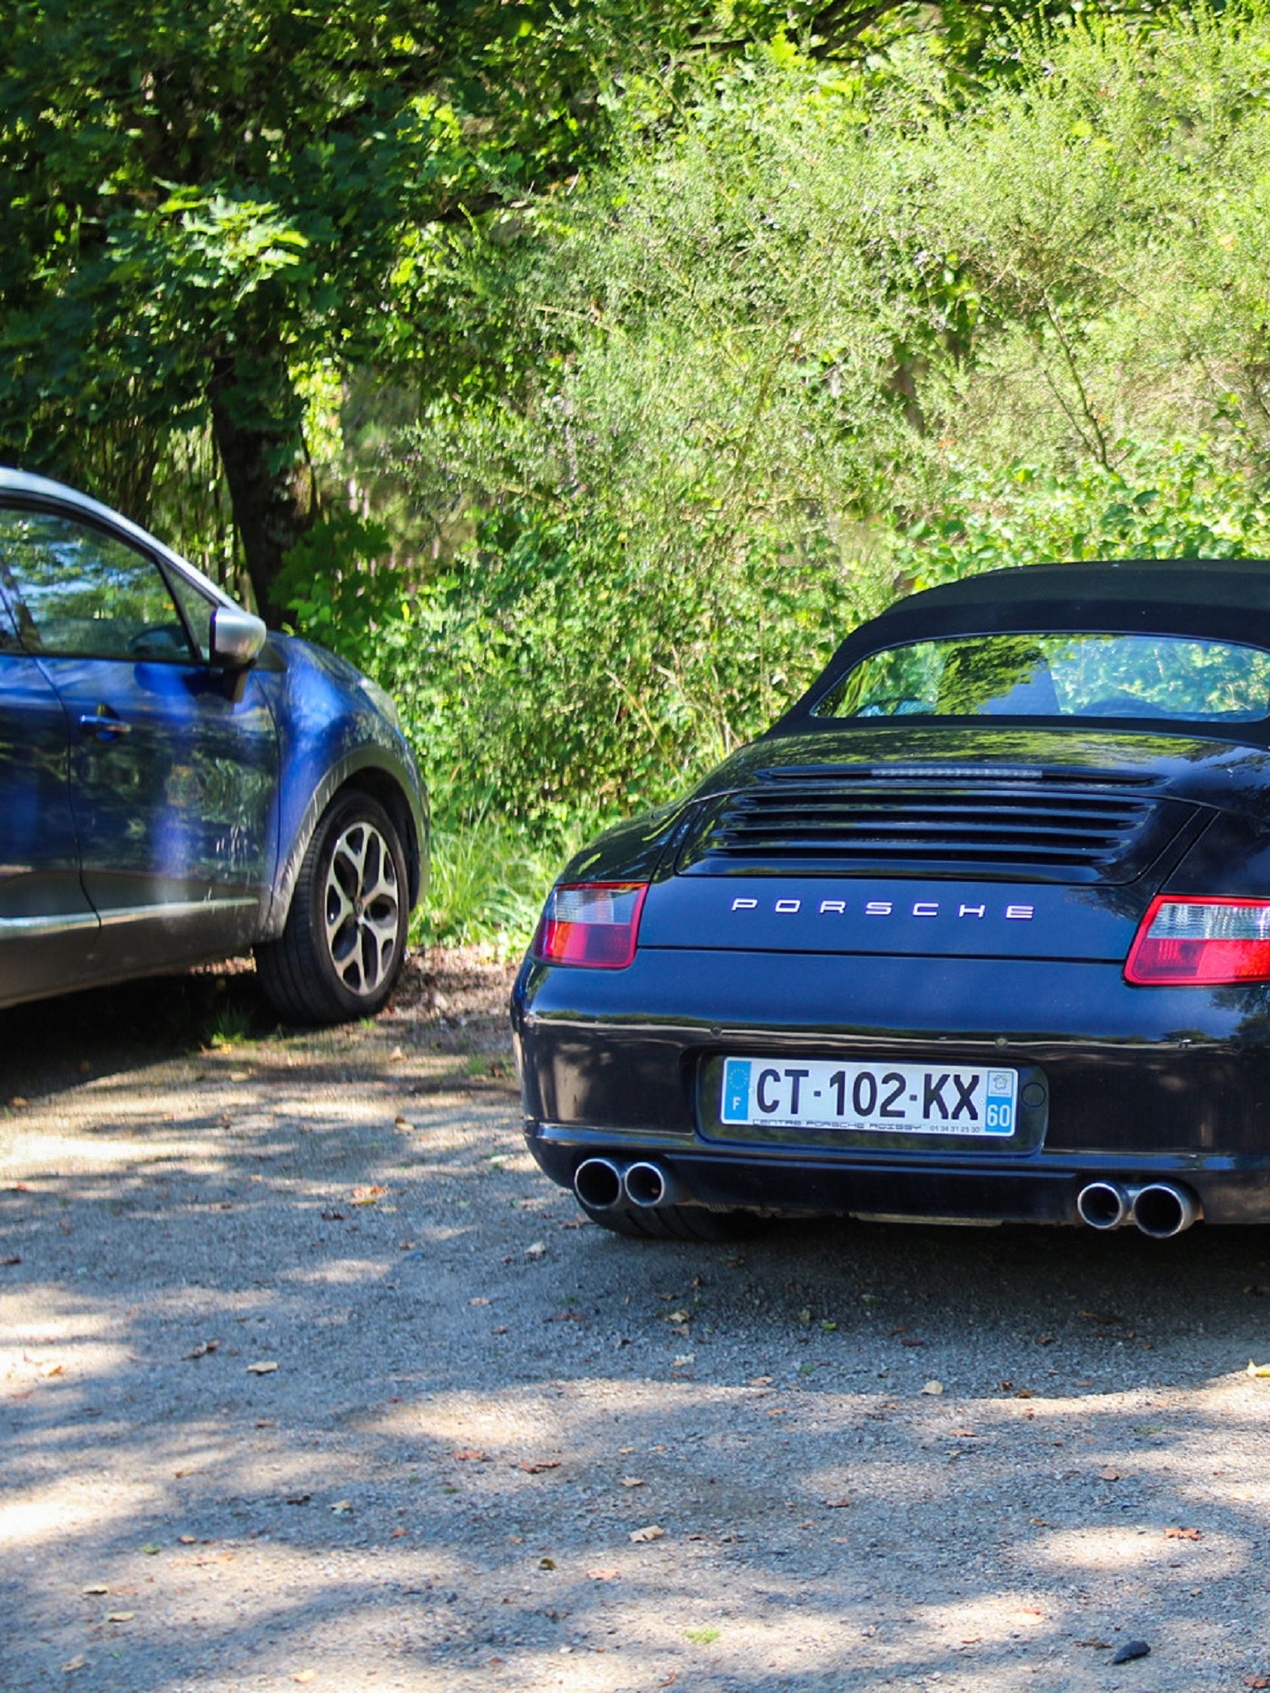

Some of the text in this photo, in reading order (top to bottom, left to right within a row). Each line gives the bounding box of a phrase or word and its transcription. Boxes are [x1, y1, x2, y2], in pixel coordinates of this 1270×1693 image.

[732, 898, 1034, 919] PORSCHE
[732, 1097, 742, 1111] F
[753, 1119, 802, 1127] CENTRE
[806, 1121, 865, 1129] PORSCHE
[987, 1104, 1011, 1127] 60
